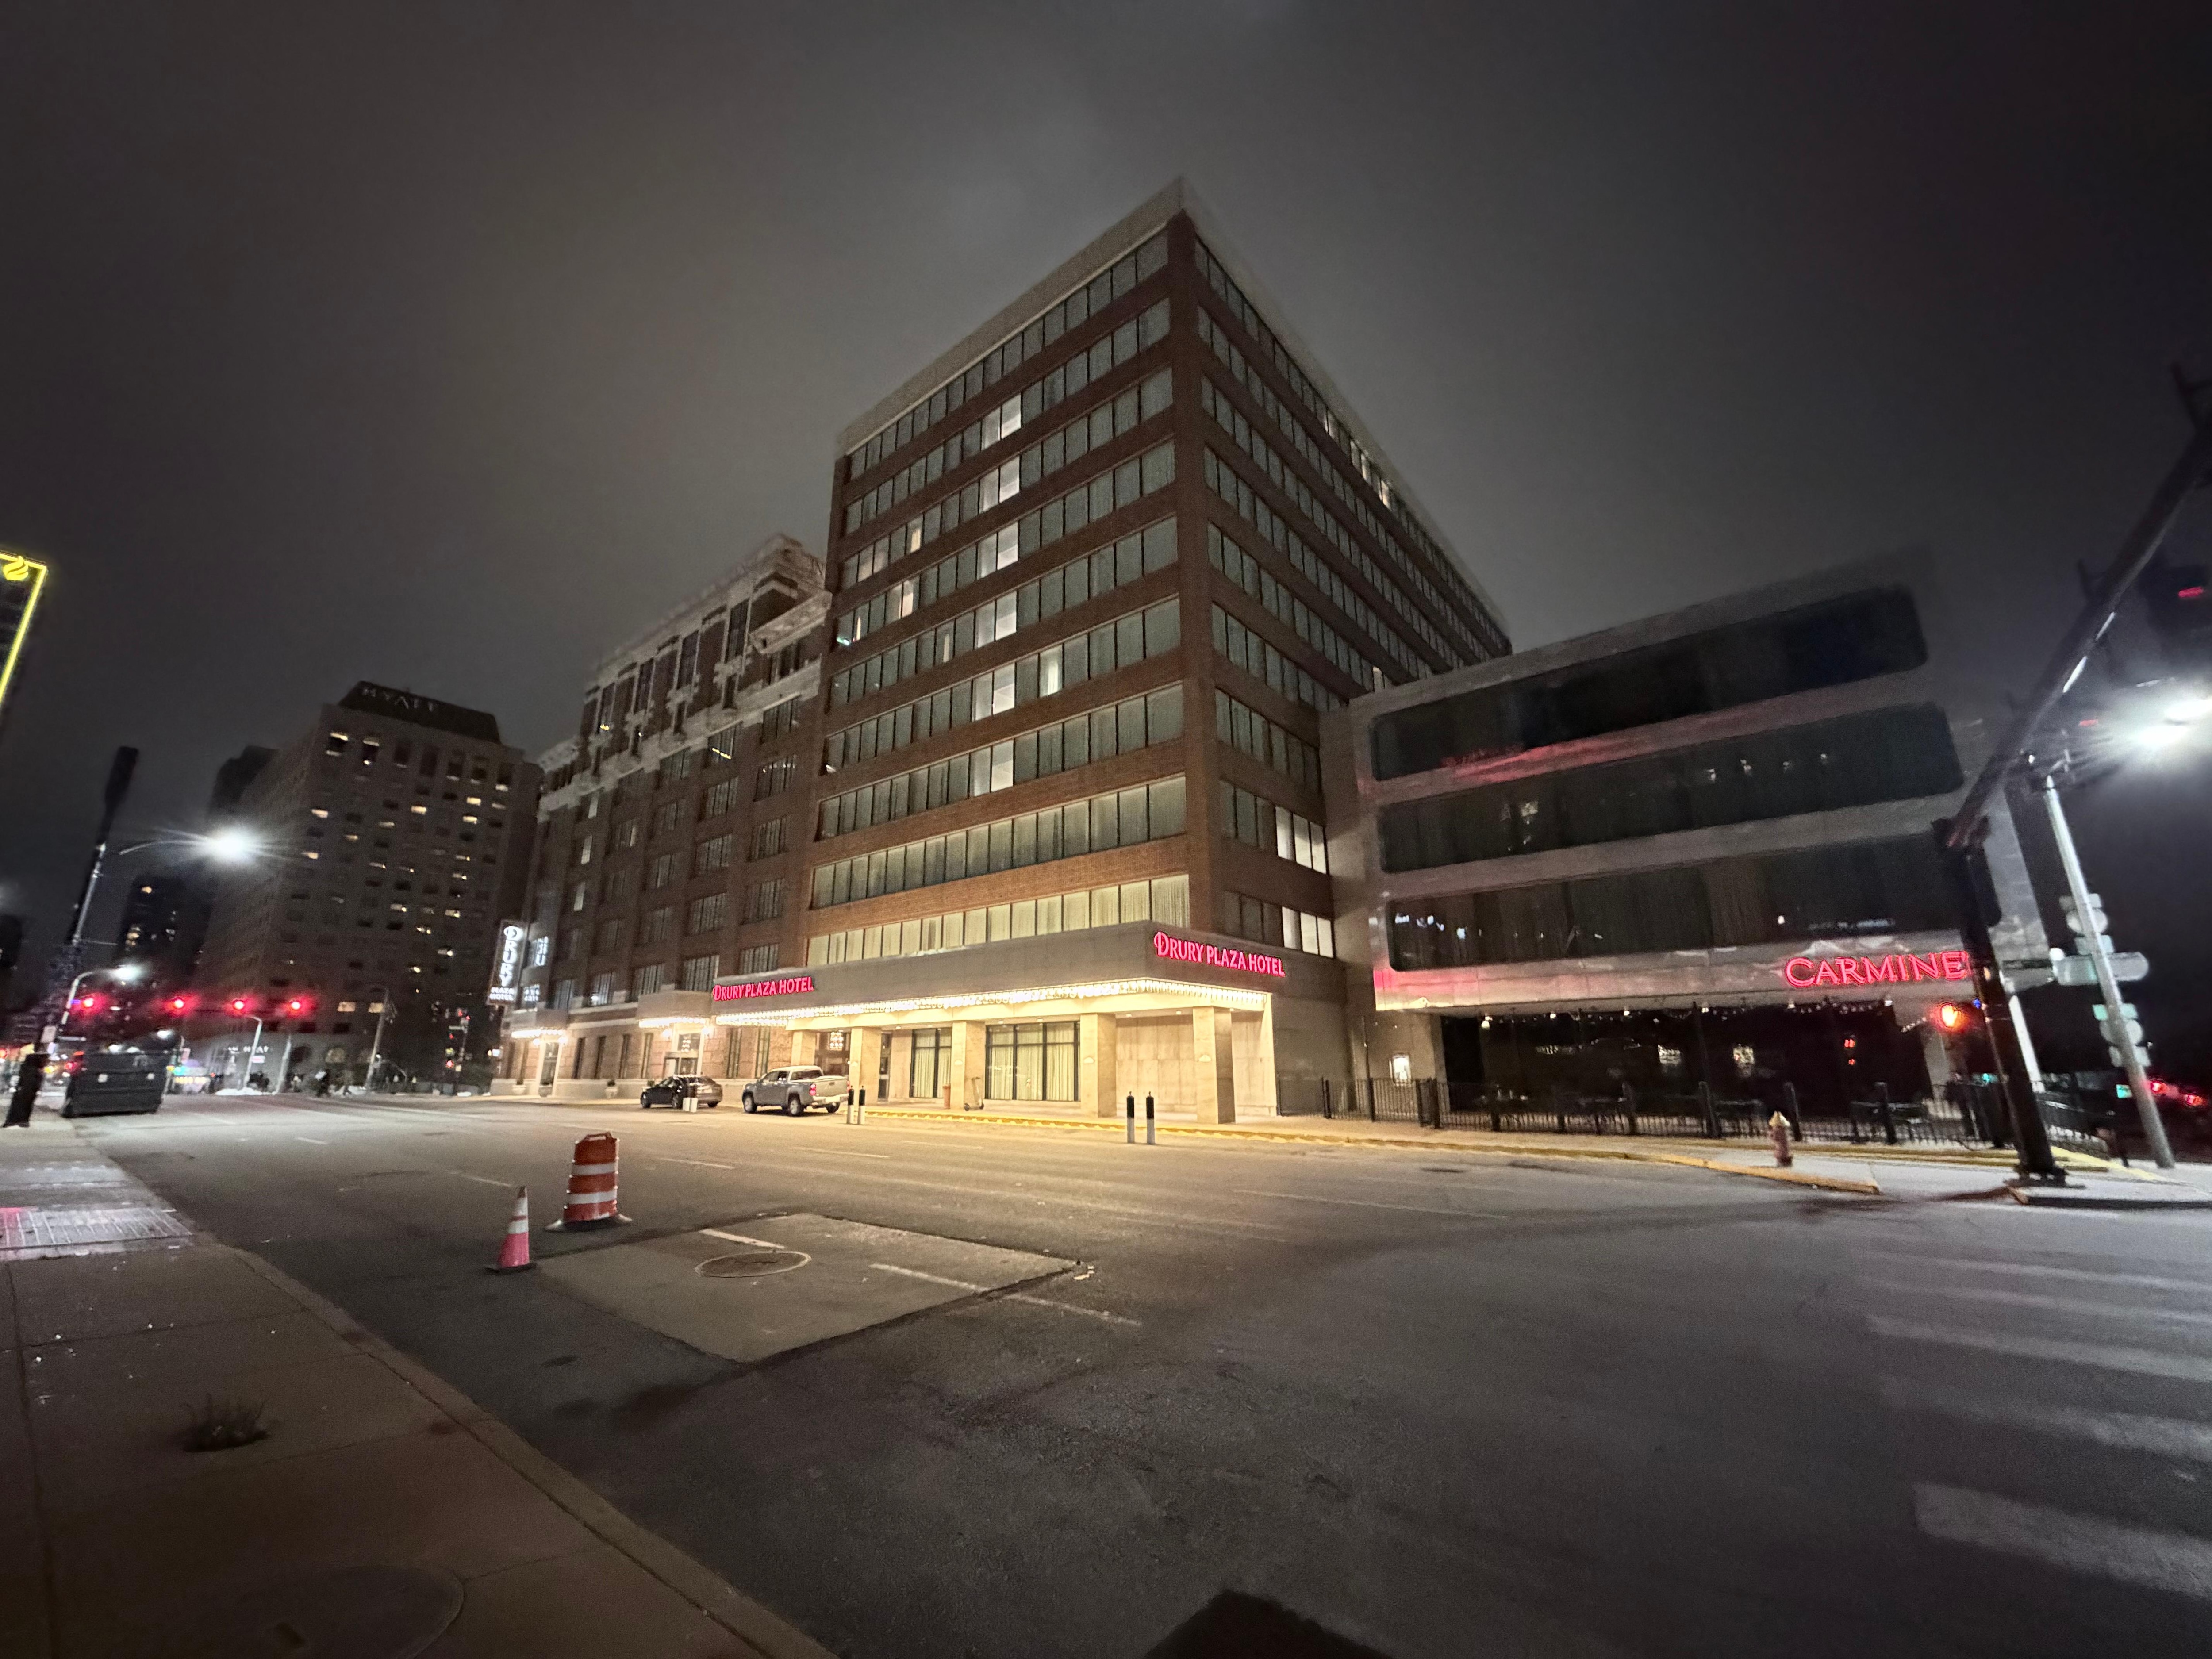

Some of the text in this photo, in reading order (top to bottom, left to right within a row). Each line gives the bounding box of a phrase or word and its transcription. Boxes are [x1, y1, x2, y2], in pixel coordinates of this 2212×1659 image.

[499, 926, 524, 987] DRURY
[1154, 931, 1286, 977] DRURY PLAZA HOTEL
[713, 976, 814, 1002] DRURY PLAZA HOTEL
